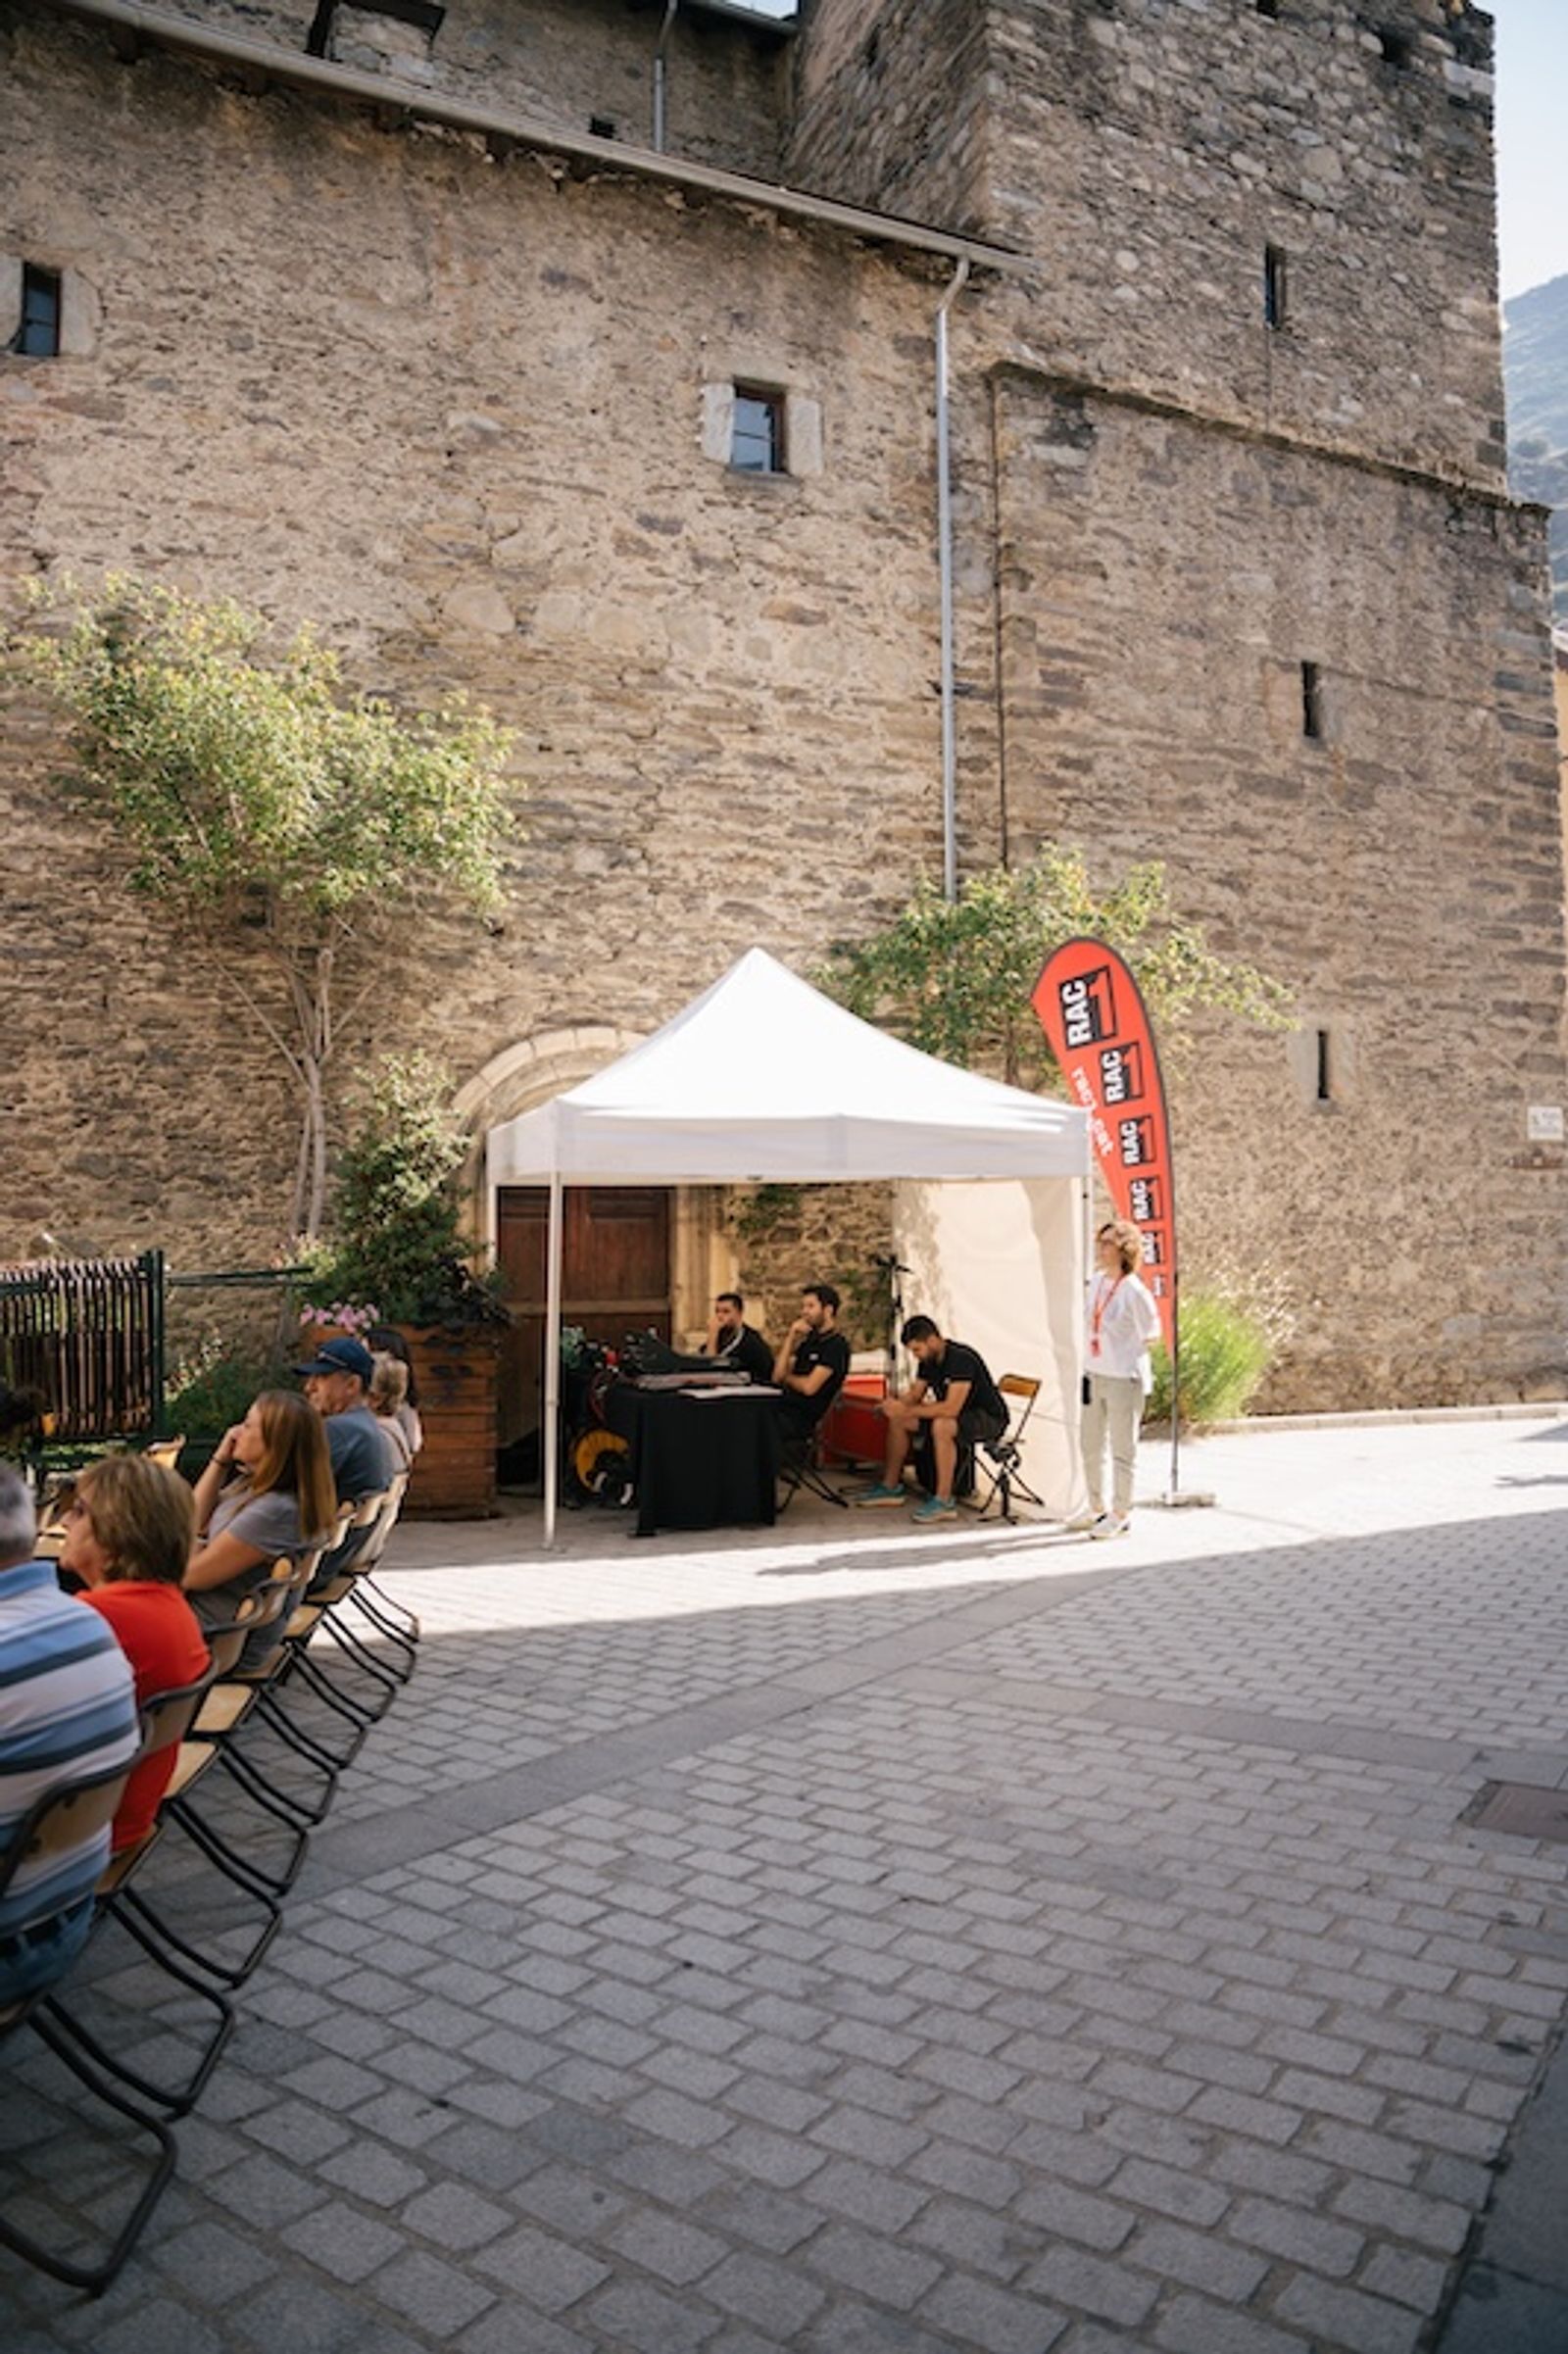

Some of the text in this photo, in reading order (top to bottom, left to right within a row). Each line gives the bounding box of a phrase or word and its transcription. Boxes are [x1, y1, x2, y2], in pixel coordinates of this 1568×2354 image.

[1061, 965, 1116, 1048] RAC1
[1102, 1042, 1144, 1103] RAC1
[1120, 1115, 1155, 1165] RAC1
